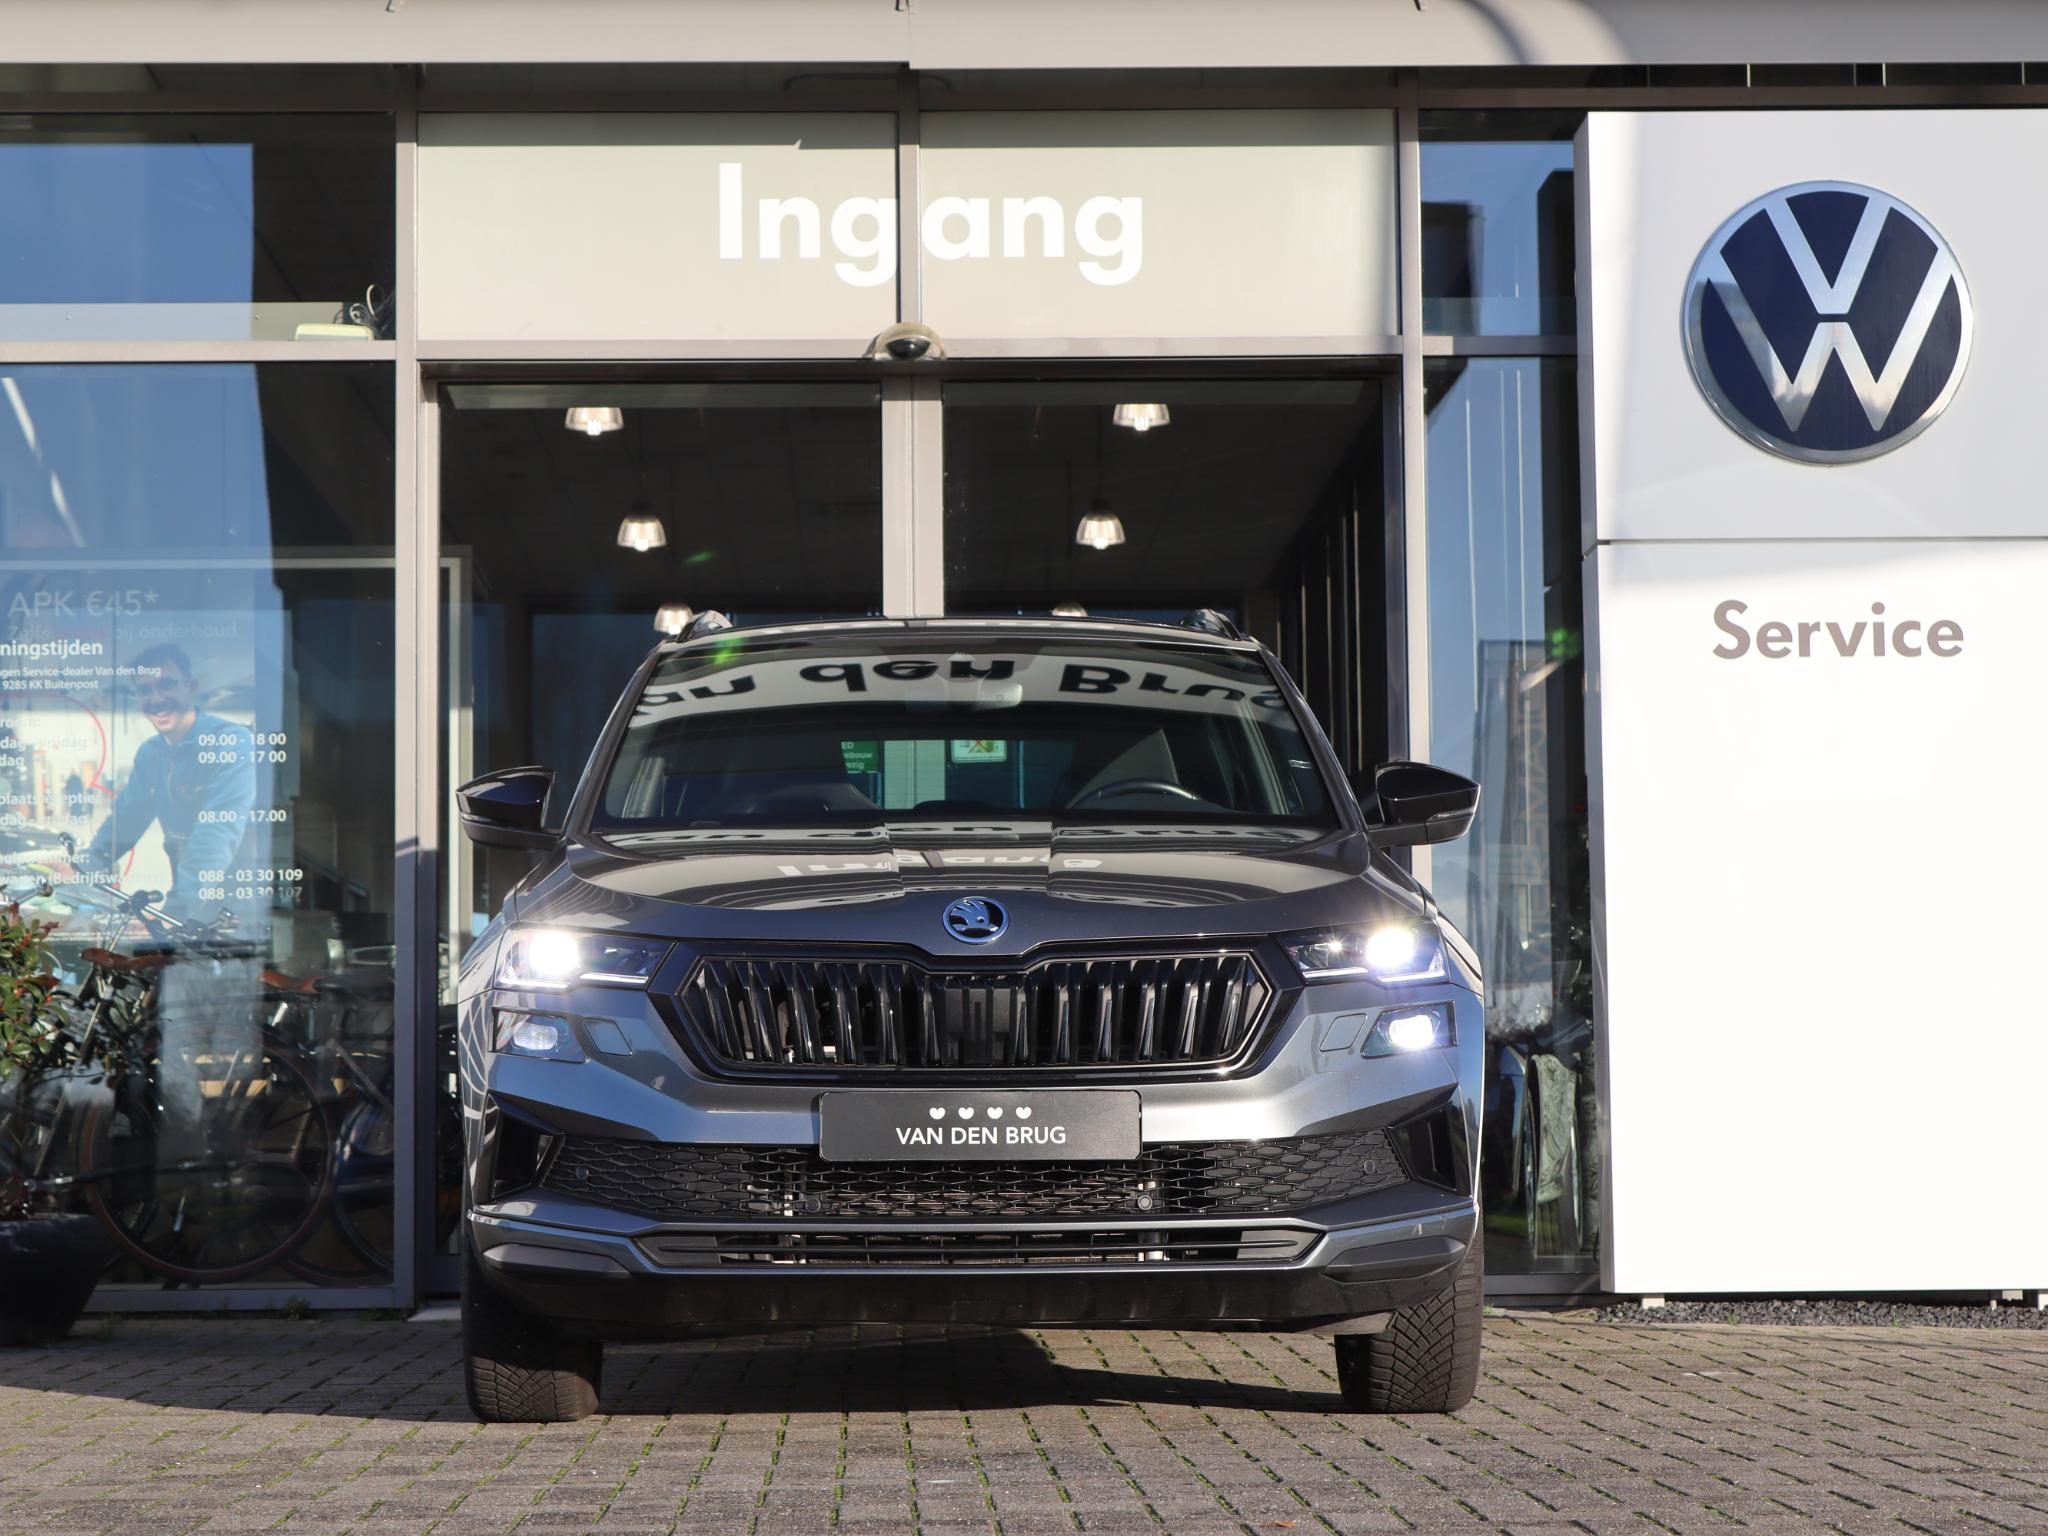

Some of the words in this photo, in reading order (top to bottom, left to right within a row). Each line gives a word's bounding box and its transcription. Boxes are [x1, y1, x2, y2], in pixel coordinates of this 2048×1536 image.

[719, 163, 1143, 287] Ingang
[8, 591, 75, 617] APK
[1712, 599, 1964, 660] Service
[23, 665, 94, 677] Service-dealer
[95, 666, 115, 676] Van
[116, 665, 136, 676] den
[137, 664, 163, 678] Brug
[45, 678, 99, 692] Buitenpost
[198, 733, 237, 747] 09.00
[198, 751, 237, 764] 09.00
[198, 810, 237, 824] 08.00
[249, 809, 288, 823] 17.00
[198, 869, 226, 883] 088
[235, 869, 254, 882] 03
[256, 868, 275, 882] 30
[278, 868, 304, 881] 109
[198, 887, 226, 900] 088
[235, 886, 254, 900] 03
[896, 1127, 943, 1145] VAN
[951, 1127, 998, 1145] DEN
[1006, 1126, 1067, 1145] BRUG
